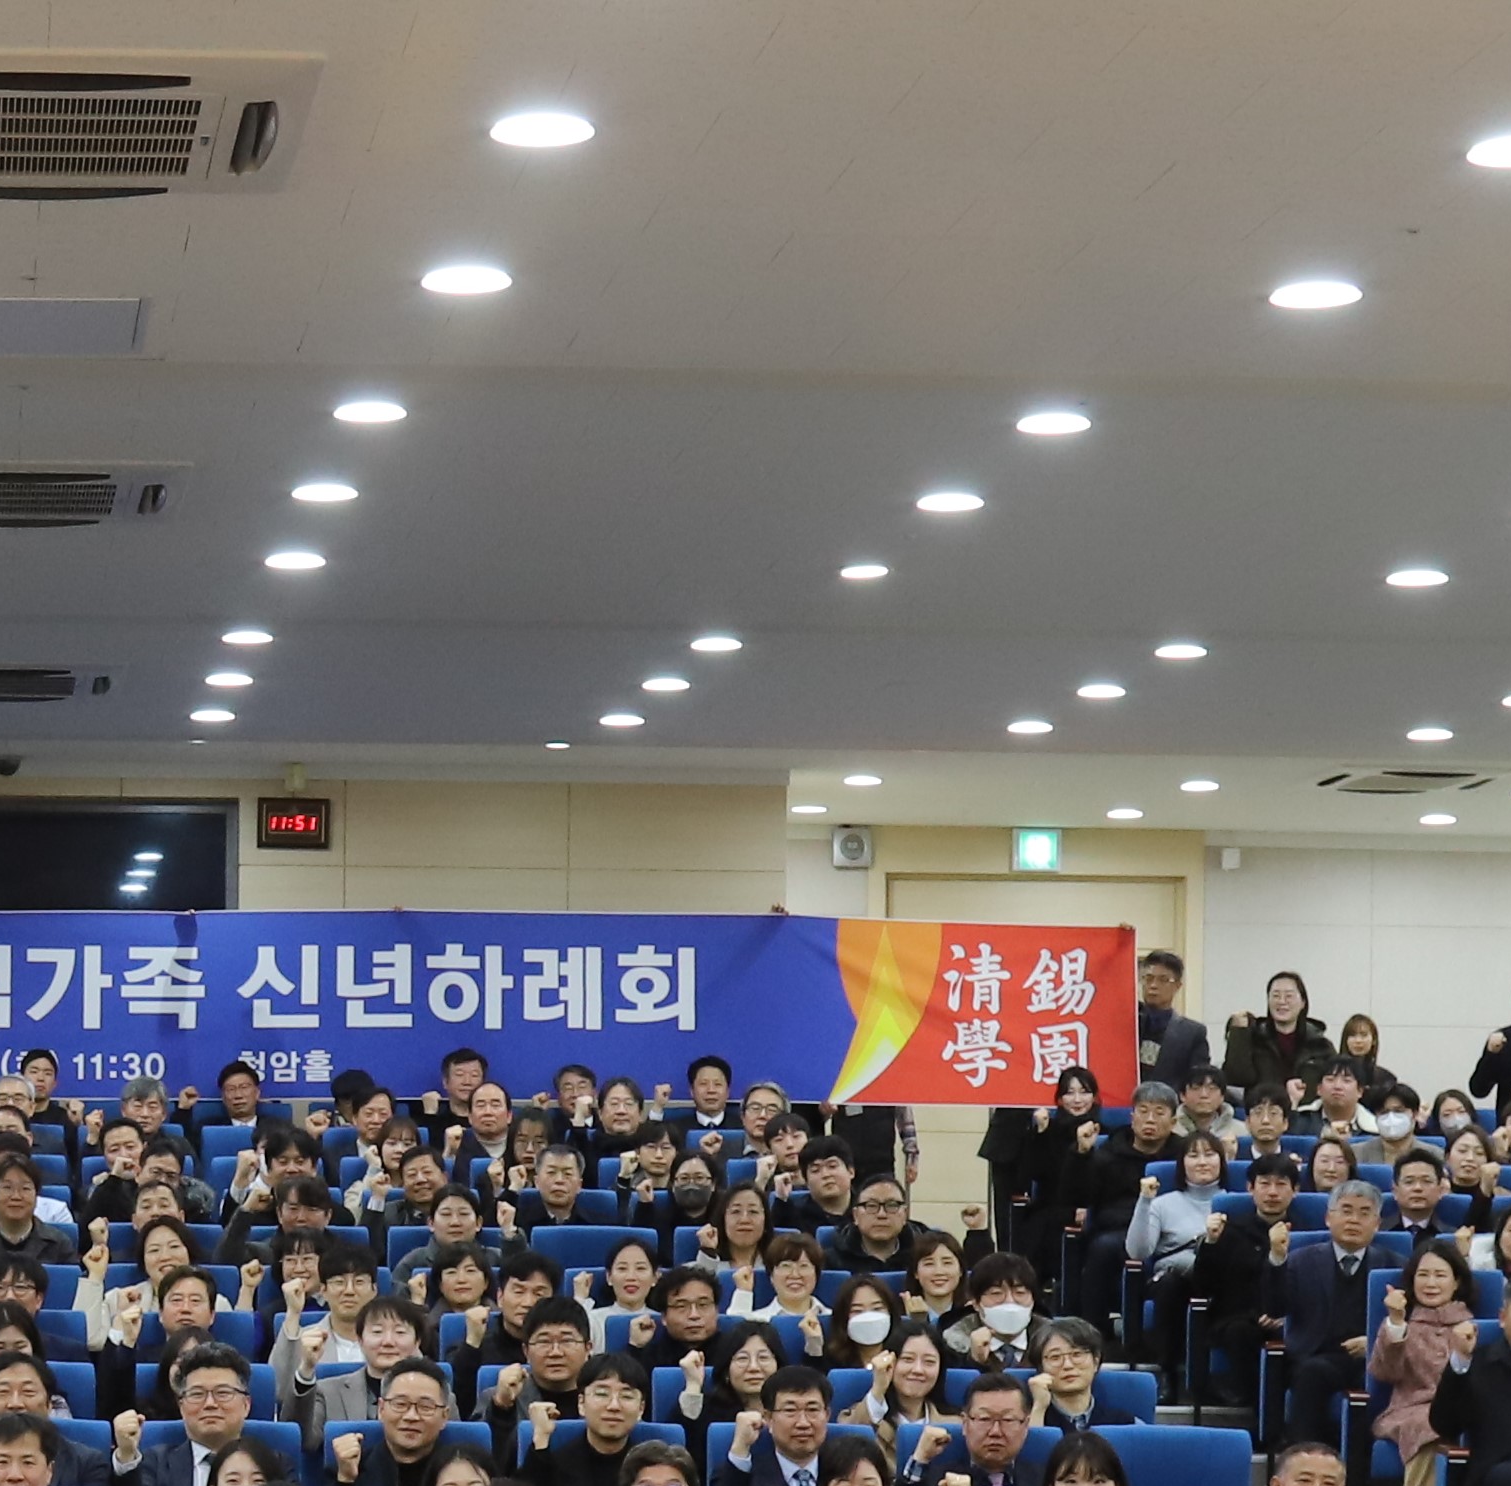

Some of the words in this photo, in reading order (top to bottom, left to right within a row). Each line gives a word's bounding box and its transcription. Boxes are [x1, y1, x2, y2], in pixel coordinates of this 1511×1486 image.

[270, 814, 318, 832] 11:51
[236, 942, 698, 1032] 신년하례회
[72, 1052, 166, 1080] 11:30
[238, 1049, 334, 1082] 청암홀
